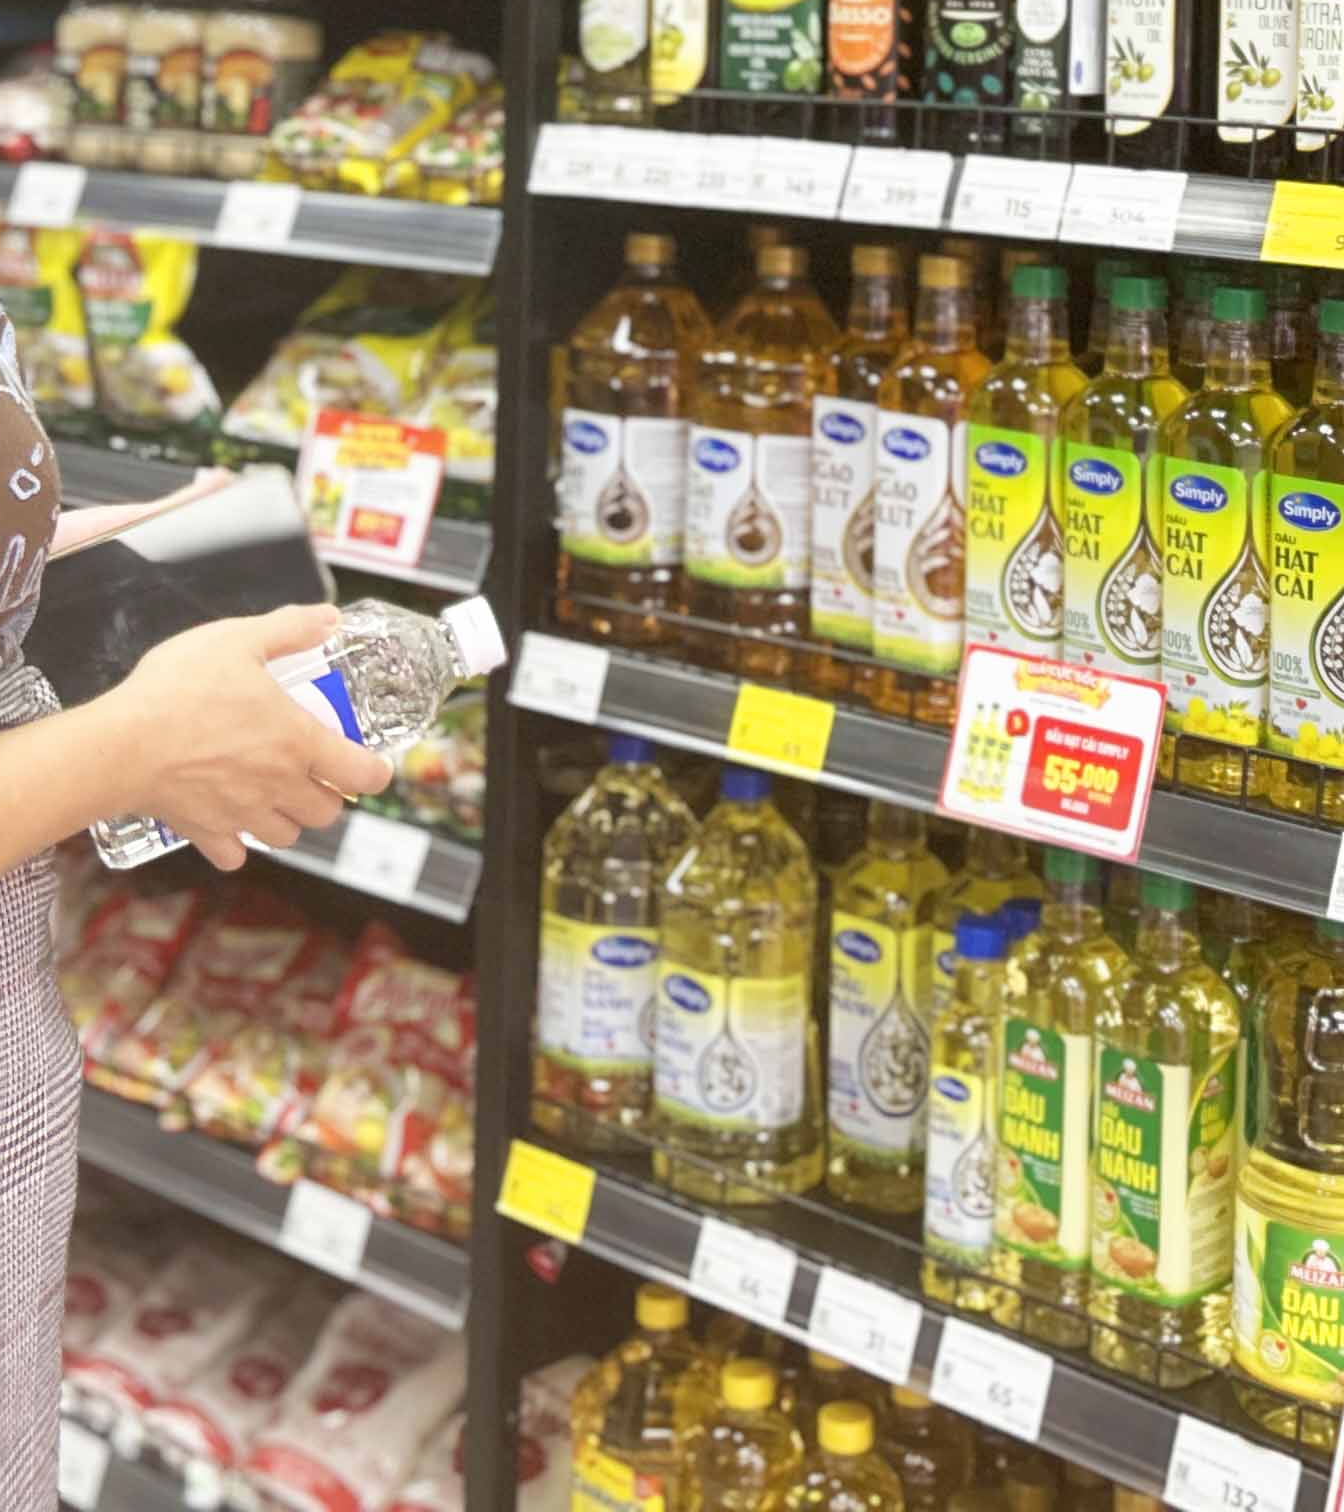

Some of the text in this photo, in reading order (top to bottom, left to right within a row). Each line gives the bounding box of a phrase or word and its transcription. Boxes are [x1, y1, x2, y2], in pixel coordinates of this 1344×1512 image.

[1257, 13, 1291, 31] OLIVE
[1072, 462, 1122, 493] Simply
[1170, 479, 1227, 512] Simply
[1282, 494, 1340, 530] Simply
[1165, 527, 1209, 558] HẠT
[1274, 545, 1320, 578] HẠT
[1274, 568, 1316, 603] CẢI
[1271, 649, 1304, 675] 100%
[1103, 1081, 1156, 1112] MEIZAN
